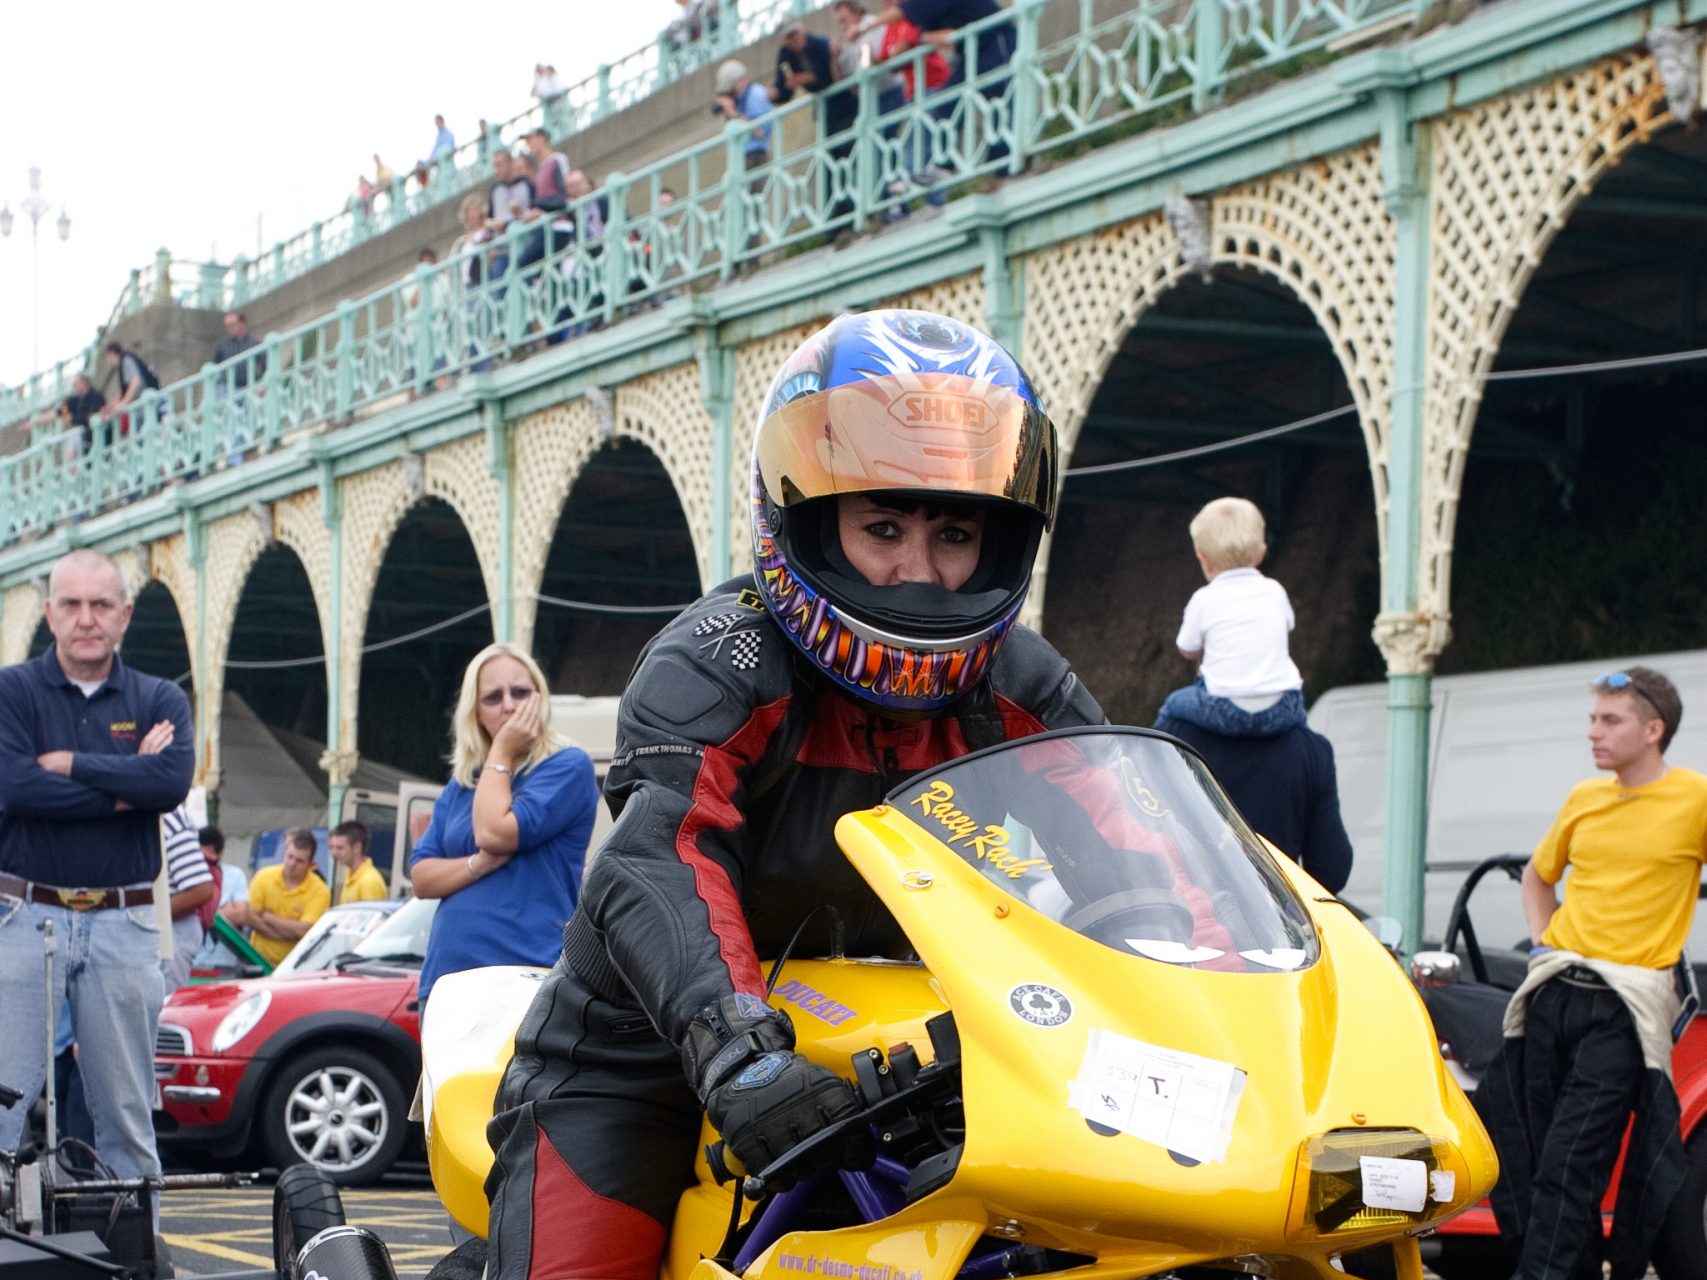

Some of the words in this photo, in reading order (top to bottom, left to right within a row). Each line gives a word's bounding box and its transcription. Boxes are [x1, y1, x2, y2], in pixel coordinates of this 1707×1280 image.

[906, 397, 986, 429] SHOEI
[636, 745, 660, 757] FRANK
[660, 744, 694, 755] THOMAS
[910, 780, 979, 844] Racey
[773, 979, 858, 1028] DUCATI
[1012, 986, 1032, 1001] ACE
[1033, 985, 1067, 1003] CAFE
[1019, 1010, 1069, 1026] LONDON
